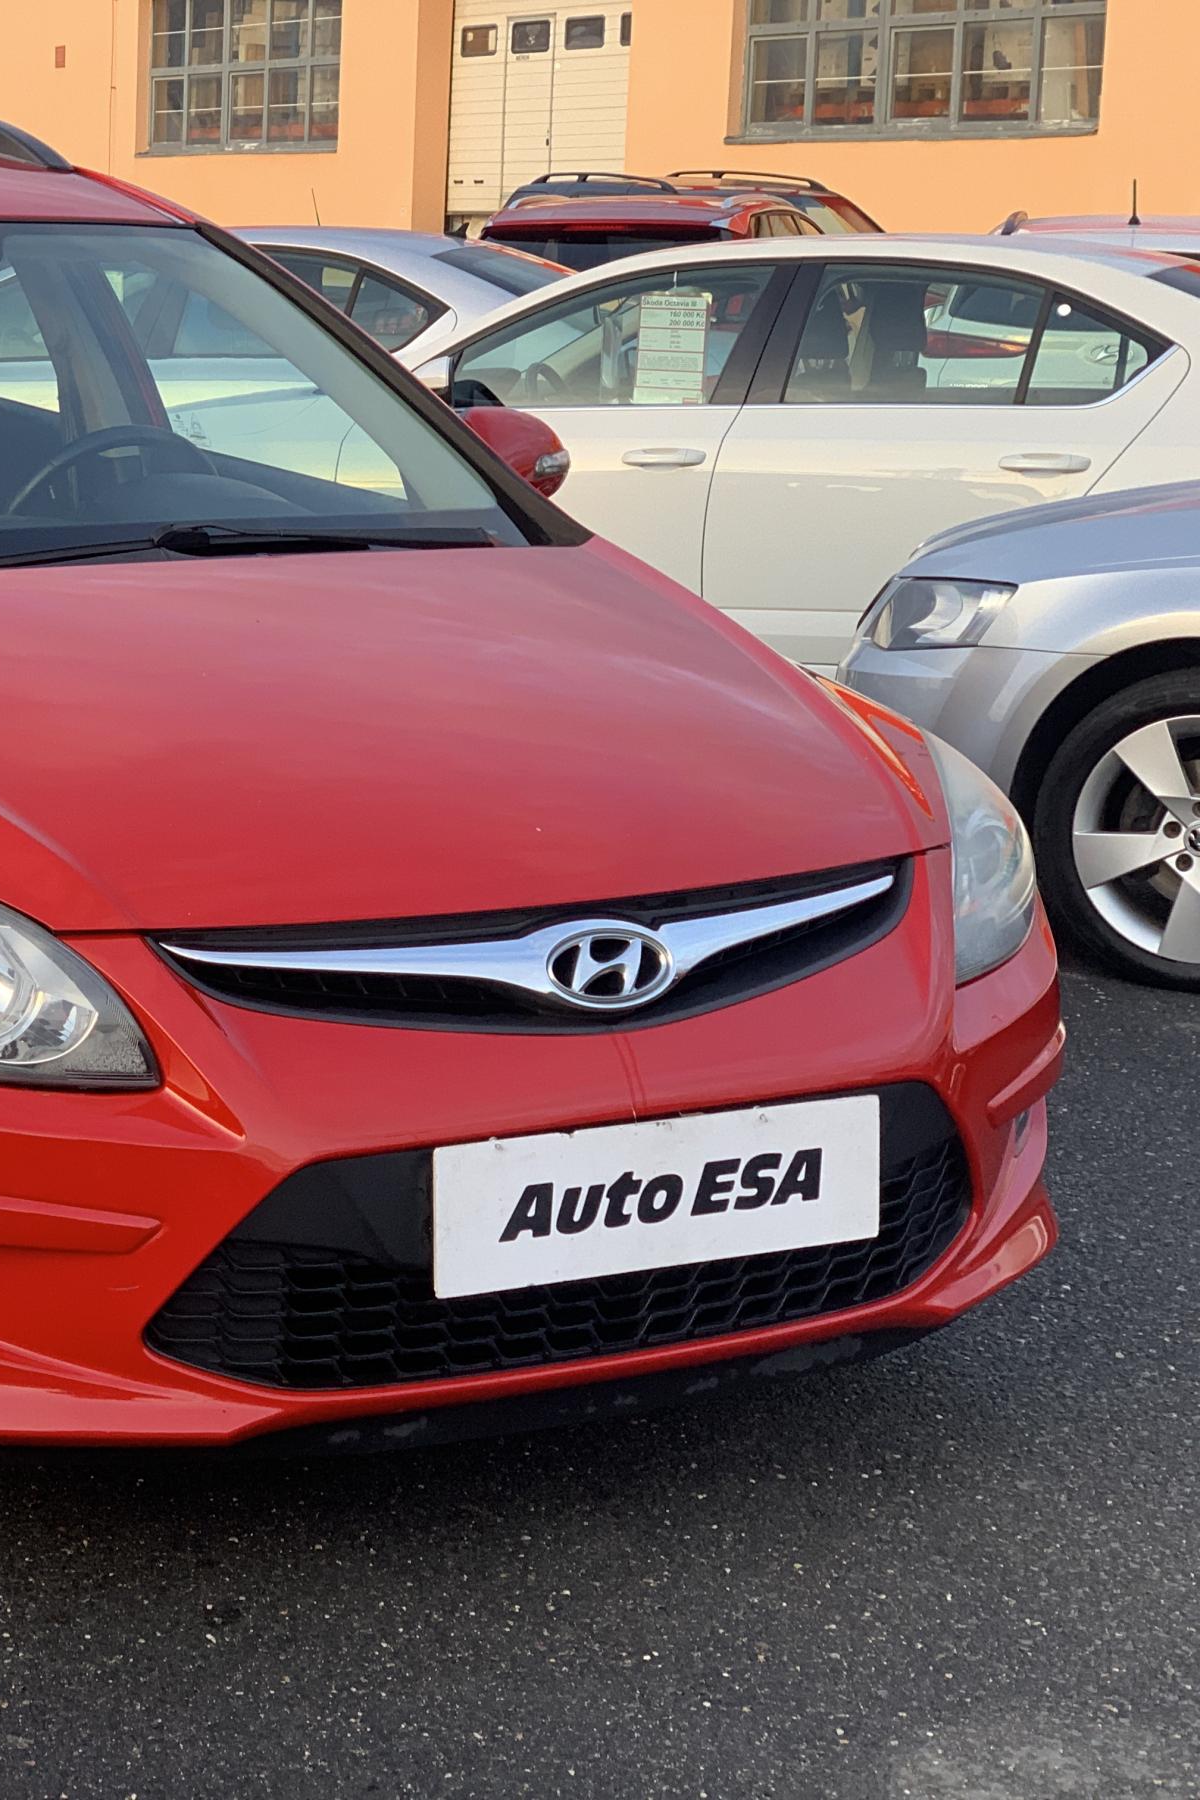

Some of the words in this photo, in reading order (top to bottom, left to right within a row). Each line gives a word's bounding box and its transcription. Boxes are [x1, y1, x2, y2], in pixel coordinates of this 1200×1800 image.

[664, 299, 690, 307] Octavia
[498, 1170, 684, 1243] Auto
[690, 1147, 823, 1217] ESA
